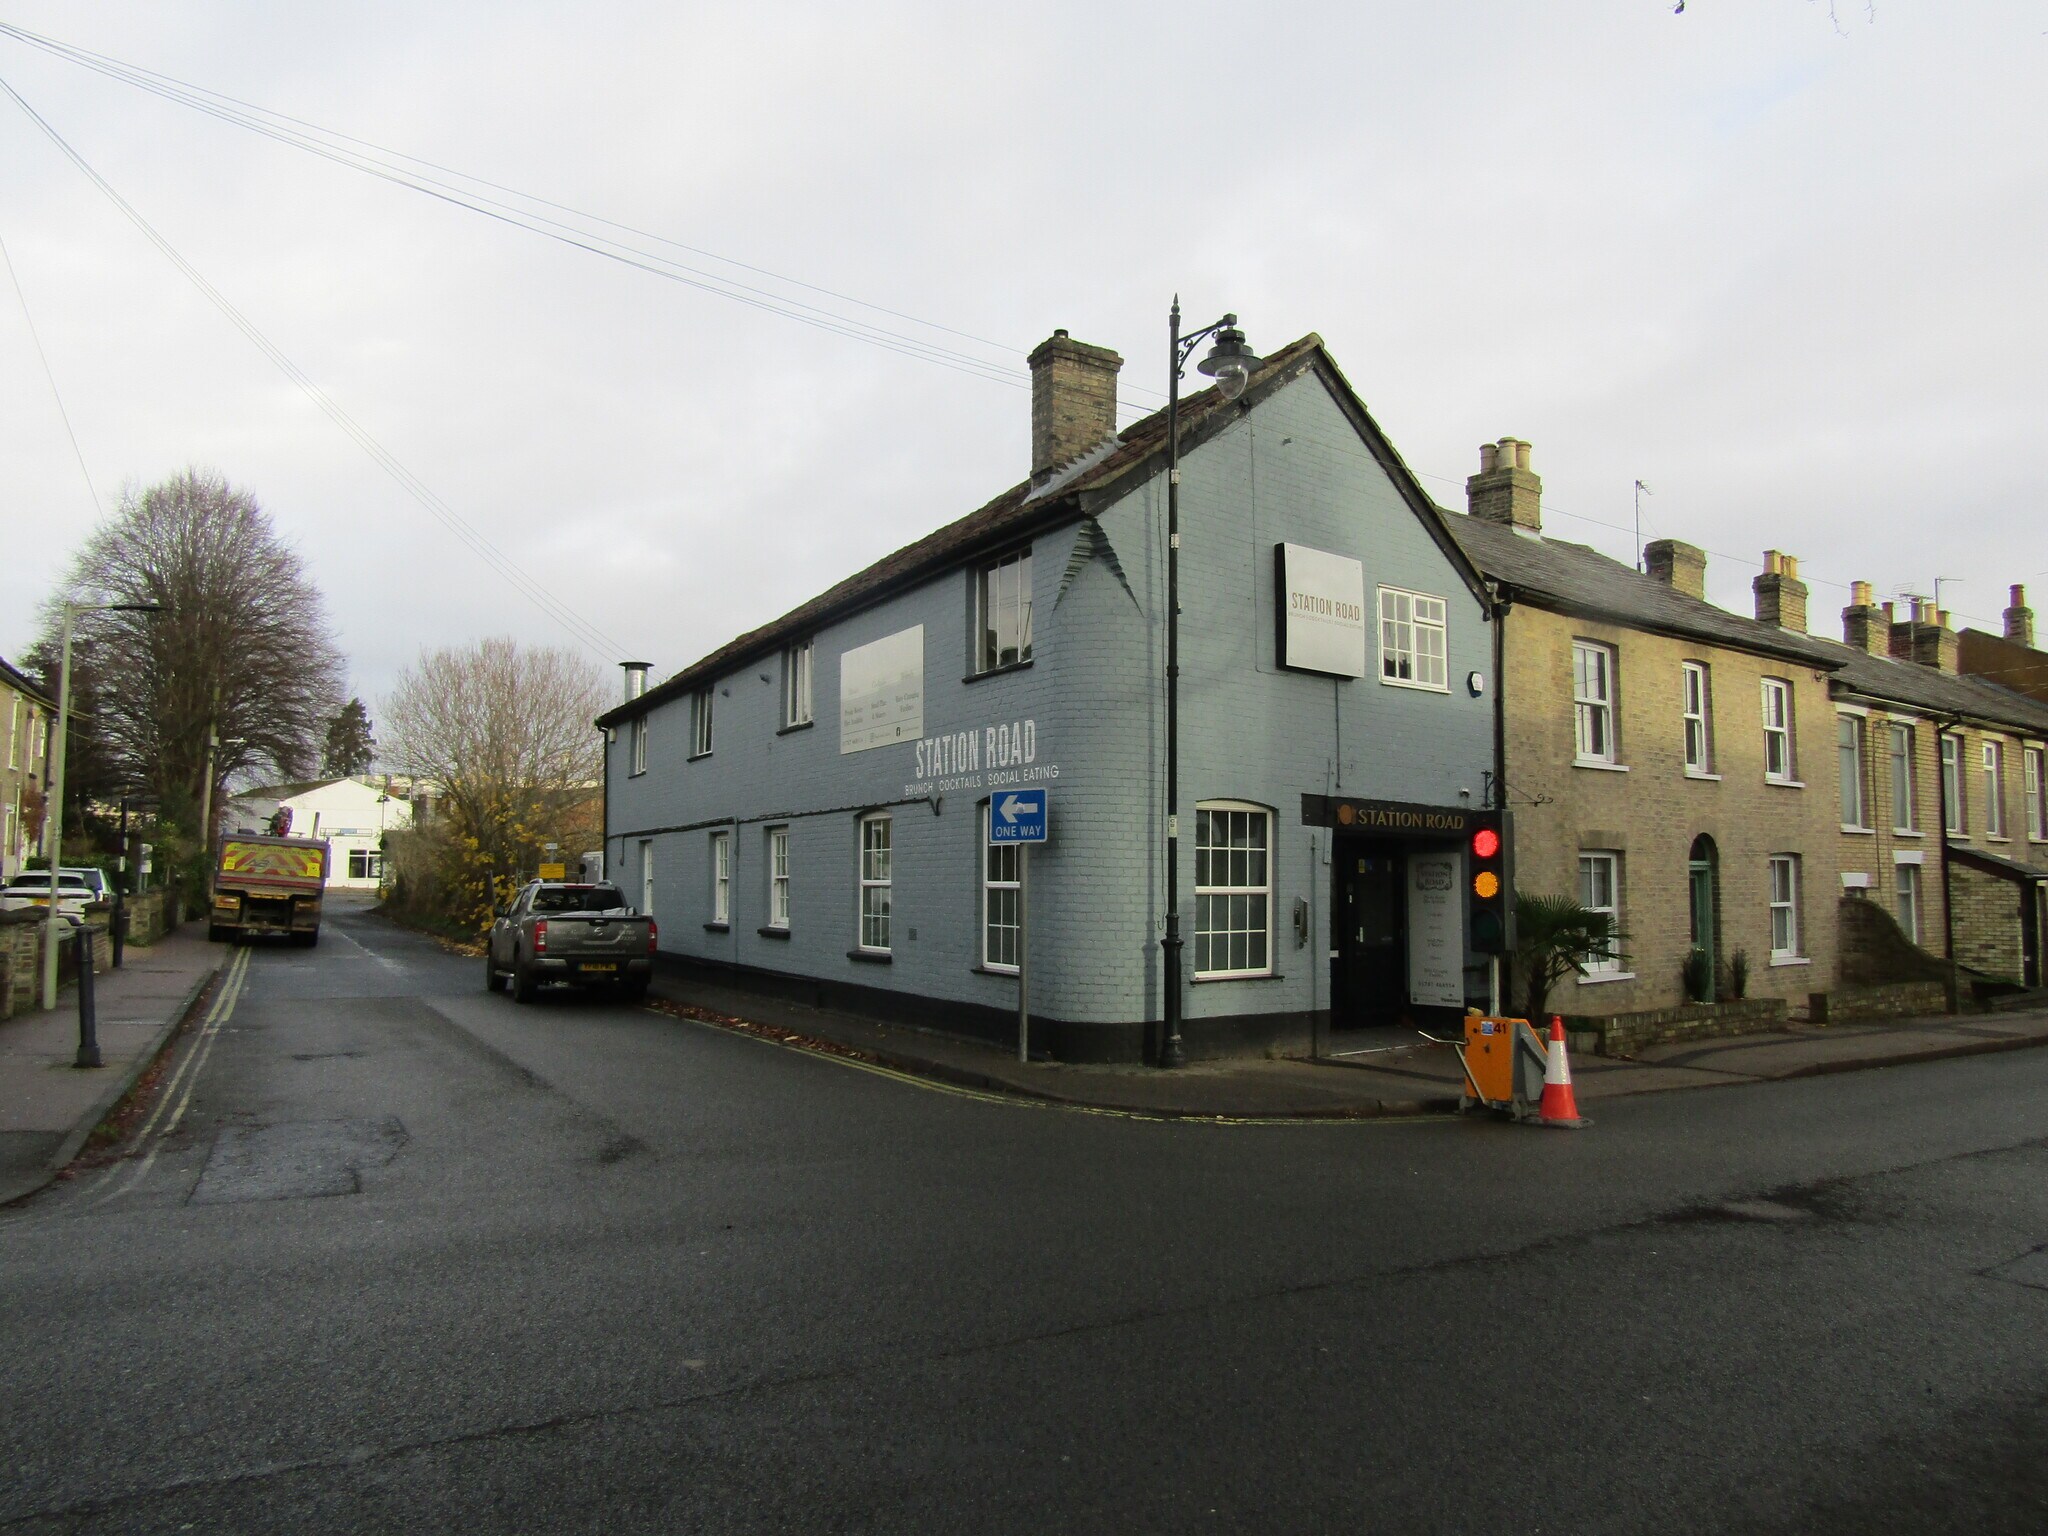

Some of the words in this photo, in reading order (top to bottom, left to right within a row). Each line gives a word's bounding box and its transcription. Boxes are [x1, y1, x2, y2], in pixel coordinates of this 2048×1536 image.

[1292, 592, 1331, 616] STATION
[1336, 602, 1360, 621] ROAD
[915, 729, 979, 779] STATION
[986, 719, 1036, 769] ROAD
[904, 781, 933, 796] BRUNCH
[938, 775, 982, 792] COCKTAILS
[987, 769, 1021, 786] SOCIAL
[1023, 764, 1060, 782] EATING
[995, 825, 1017, 838] ONE
[1020, 825, 1042, 837] WAY
[1358, 809, 1422, 828] STATION
[1426, 814, 1464, 830] ROAD
[1493, 1022, 1507, 1034] 41
